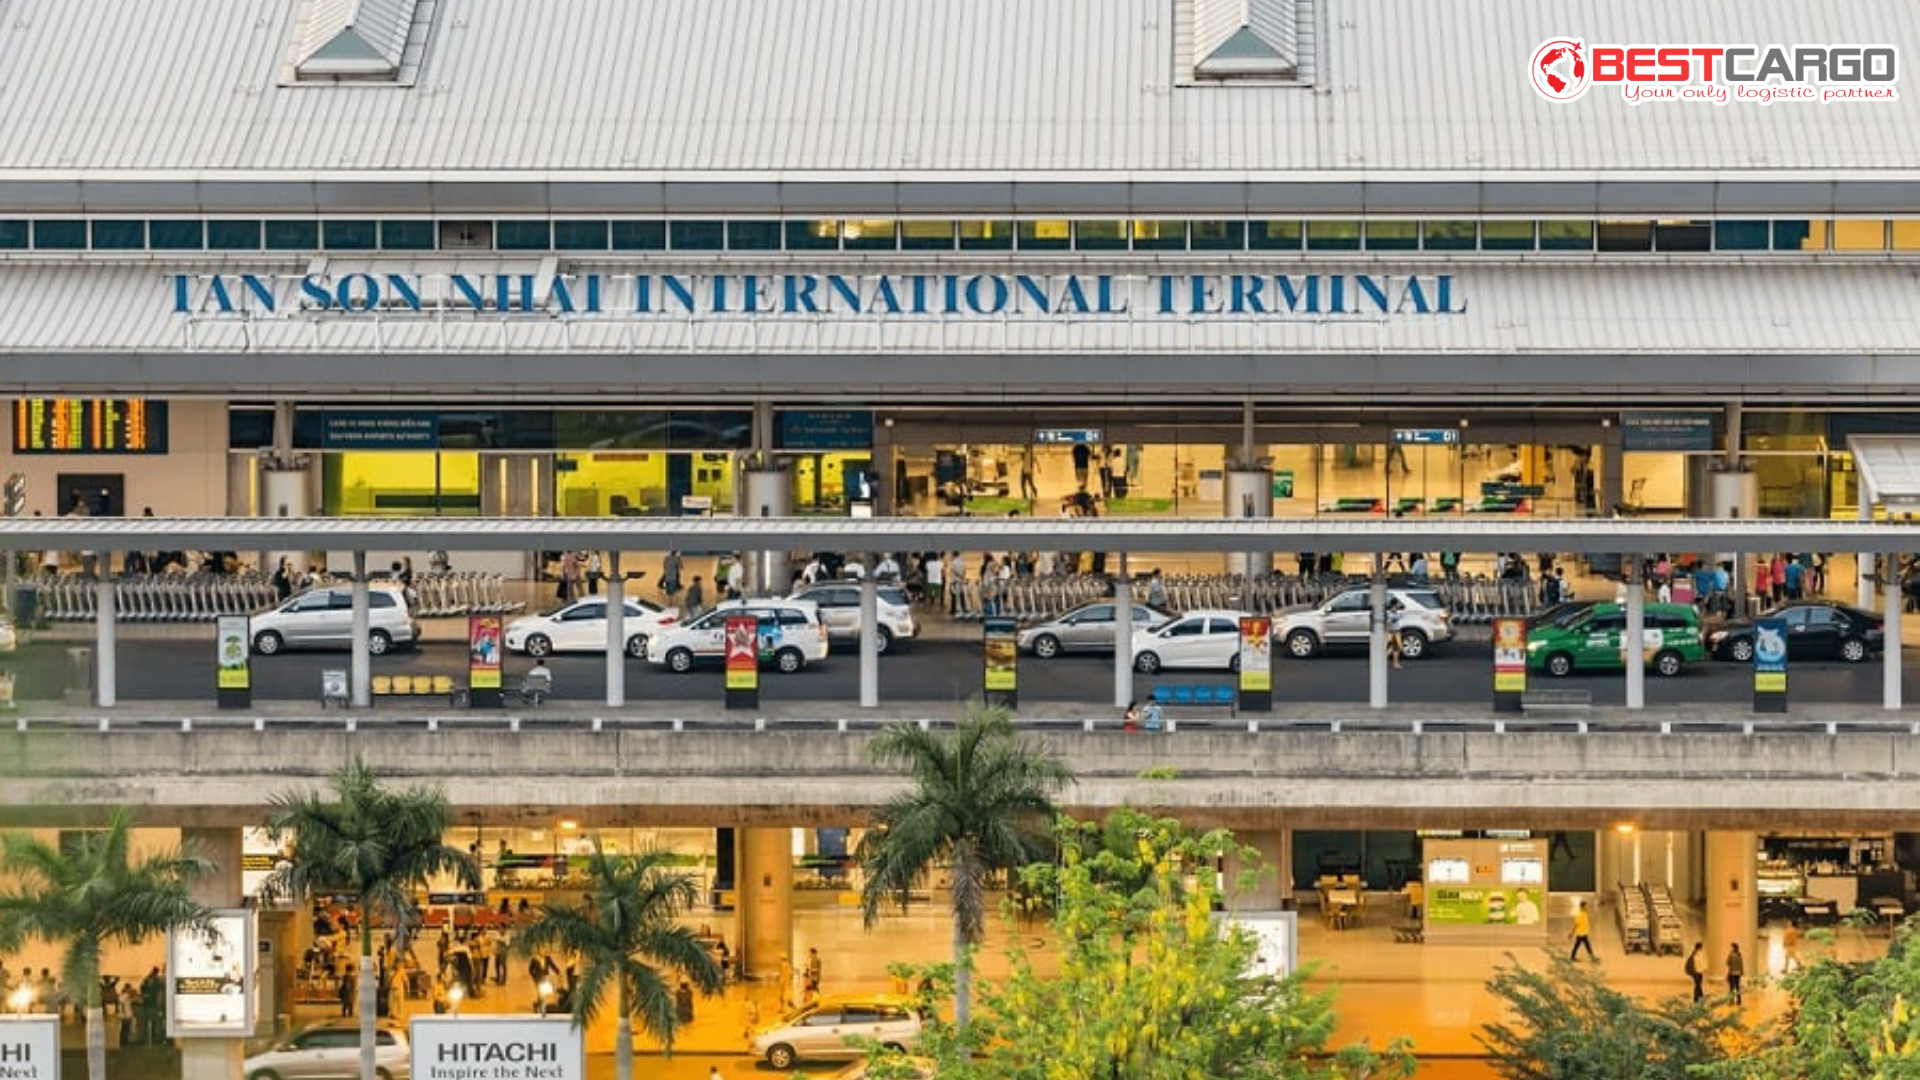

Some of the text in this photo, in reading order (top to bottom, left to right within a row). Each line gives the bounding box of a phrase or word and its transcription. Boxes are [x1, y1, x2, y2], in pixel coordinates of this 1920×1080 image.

[164, 275, 1468, 314] TAN SON NHAT INTERNATIONAL TERMINAL
[438, 1042, 557, 1062] HITACHI
[430, 1065, 563, 1080] Inspire the Next
